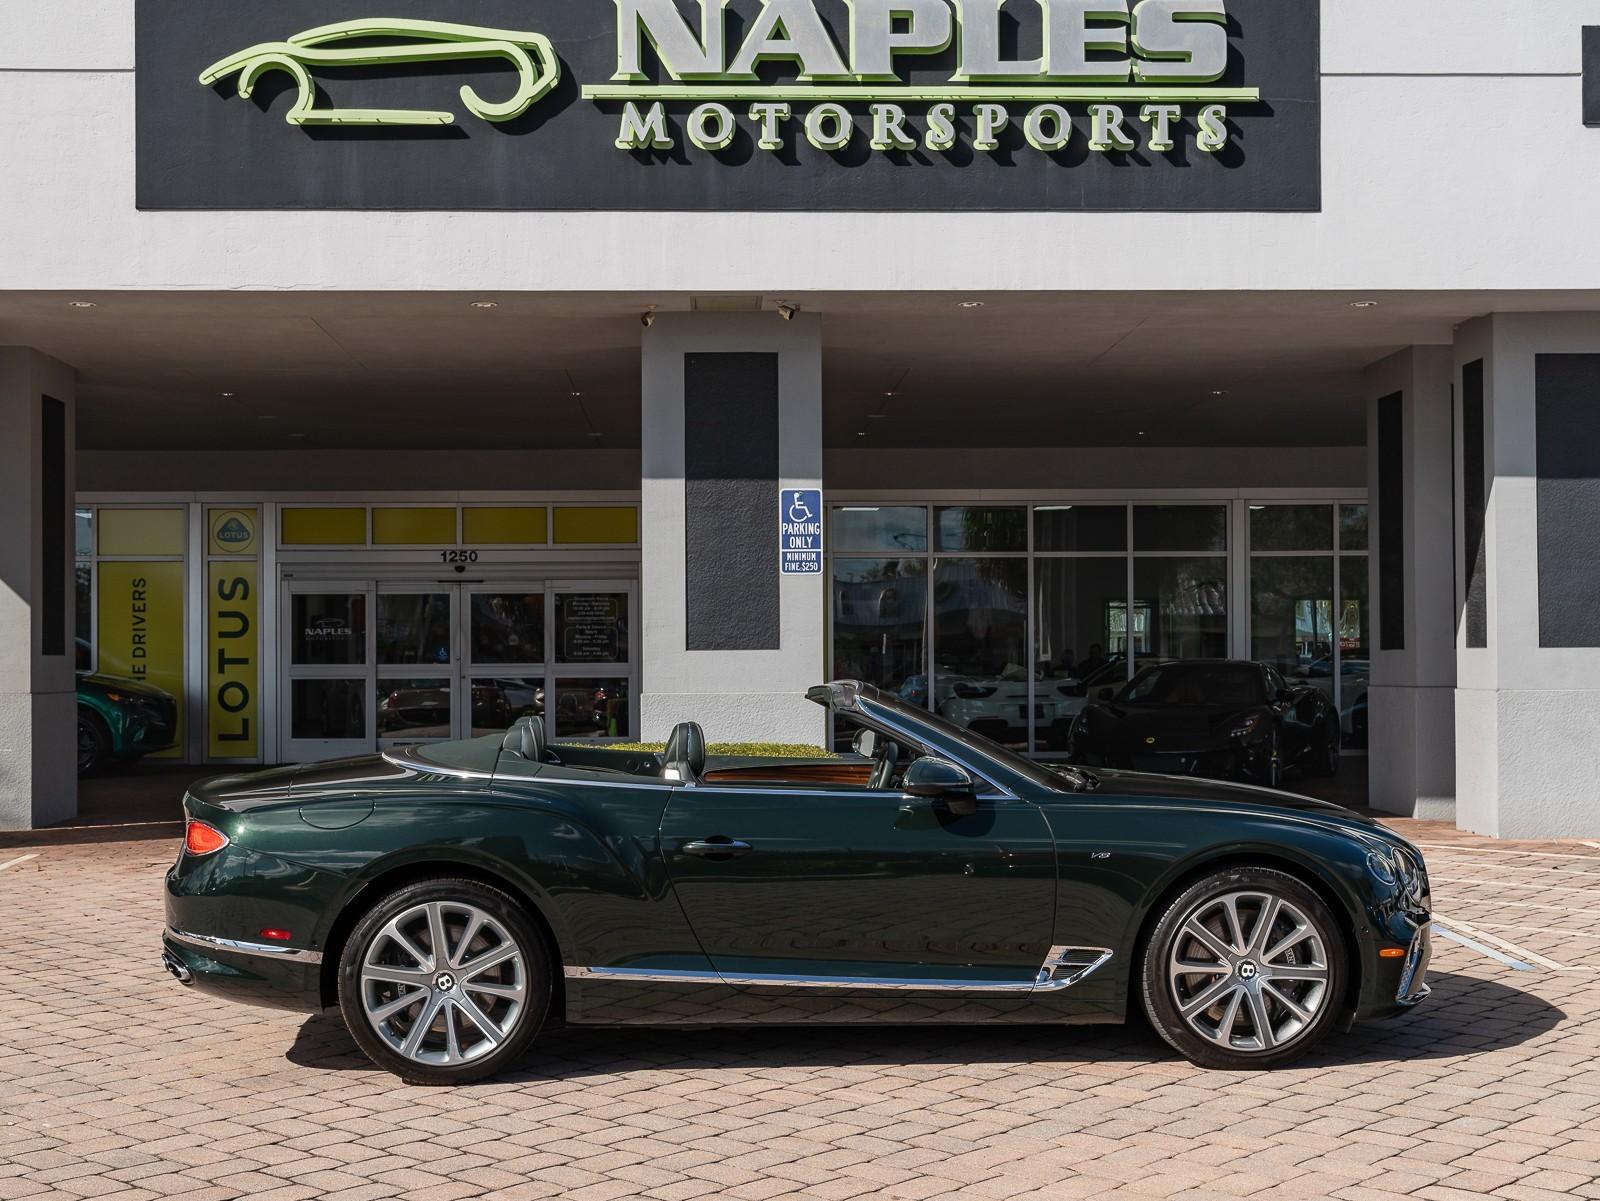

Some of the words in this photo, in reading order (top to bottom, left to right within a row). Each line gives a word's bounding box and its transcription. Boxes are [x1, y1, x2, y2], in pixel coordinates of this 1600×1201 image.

[610, 0, 1228, 82] NAPLES
[614, 102, 1228, 151] MOTORSPORTS
[782, 522, 820, 535] PARKING
[218, 531, 249, 539] LOTUS
[789, 536, 813, 548] ONLY
[440, 550, 478, 562] 1250
[786, 552, 816, 561] MINIMUM
[784, 562, 800, 571] FINE
[801, 562, 818, 572] $250
[132, 577, 147, 658] DRIVERS
[304, 627, 353, 636] NAPLES
[217, 576, 250, 742] LOTUS
